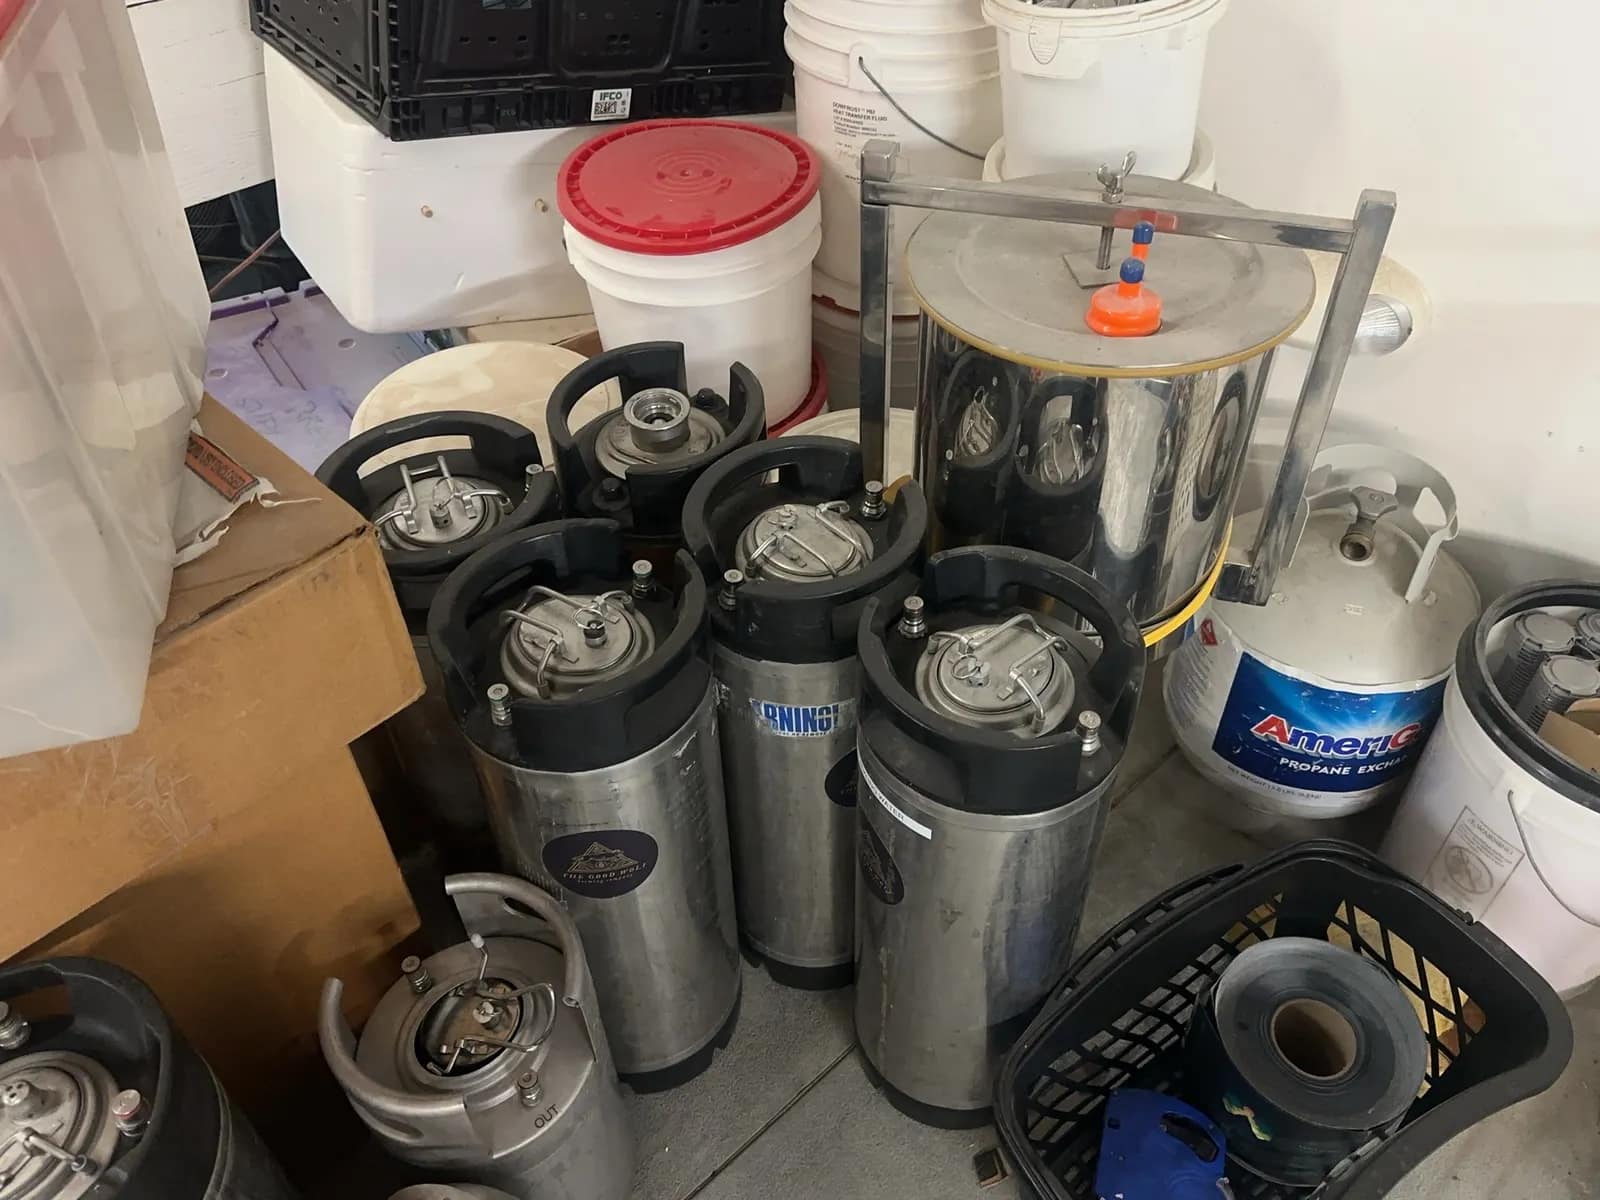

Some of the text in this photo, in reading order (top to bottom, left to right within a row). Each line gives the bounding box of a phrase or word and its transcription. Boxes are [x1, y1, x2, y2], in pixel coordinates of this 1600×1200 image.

[600, 91, 622, 100] IFCO
[751, 701, 839, 733] RNING!
[1279, 757, 1351, 775] PROPANE
[588, 872, 616, 880] GOOD
[535, 1103, 558, 1128] OUT
